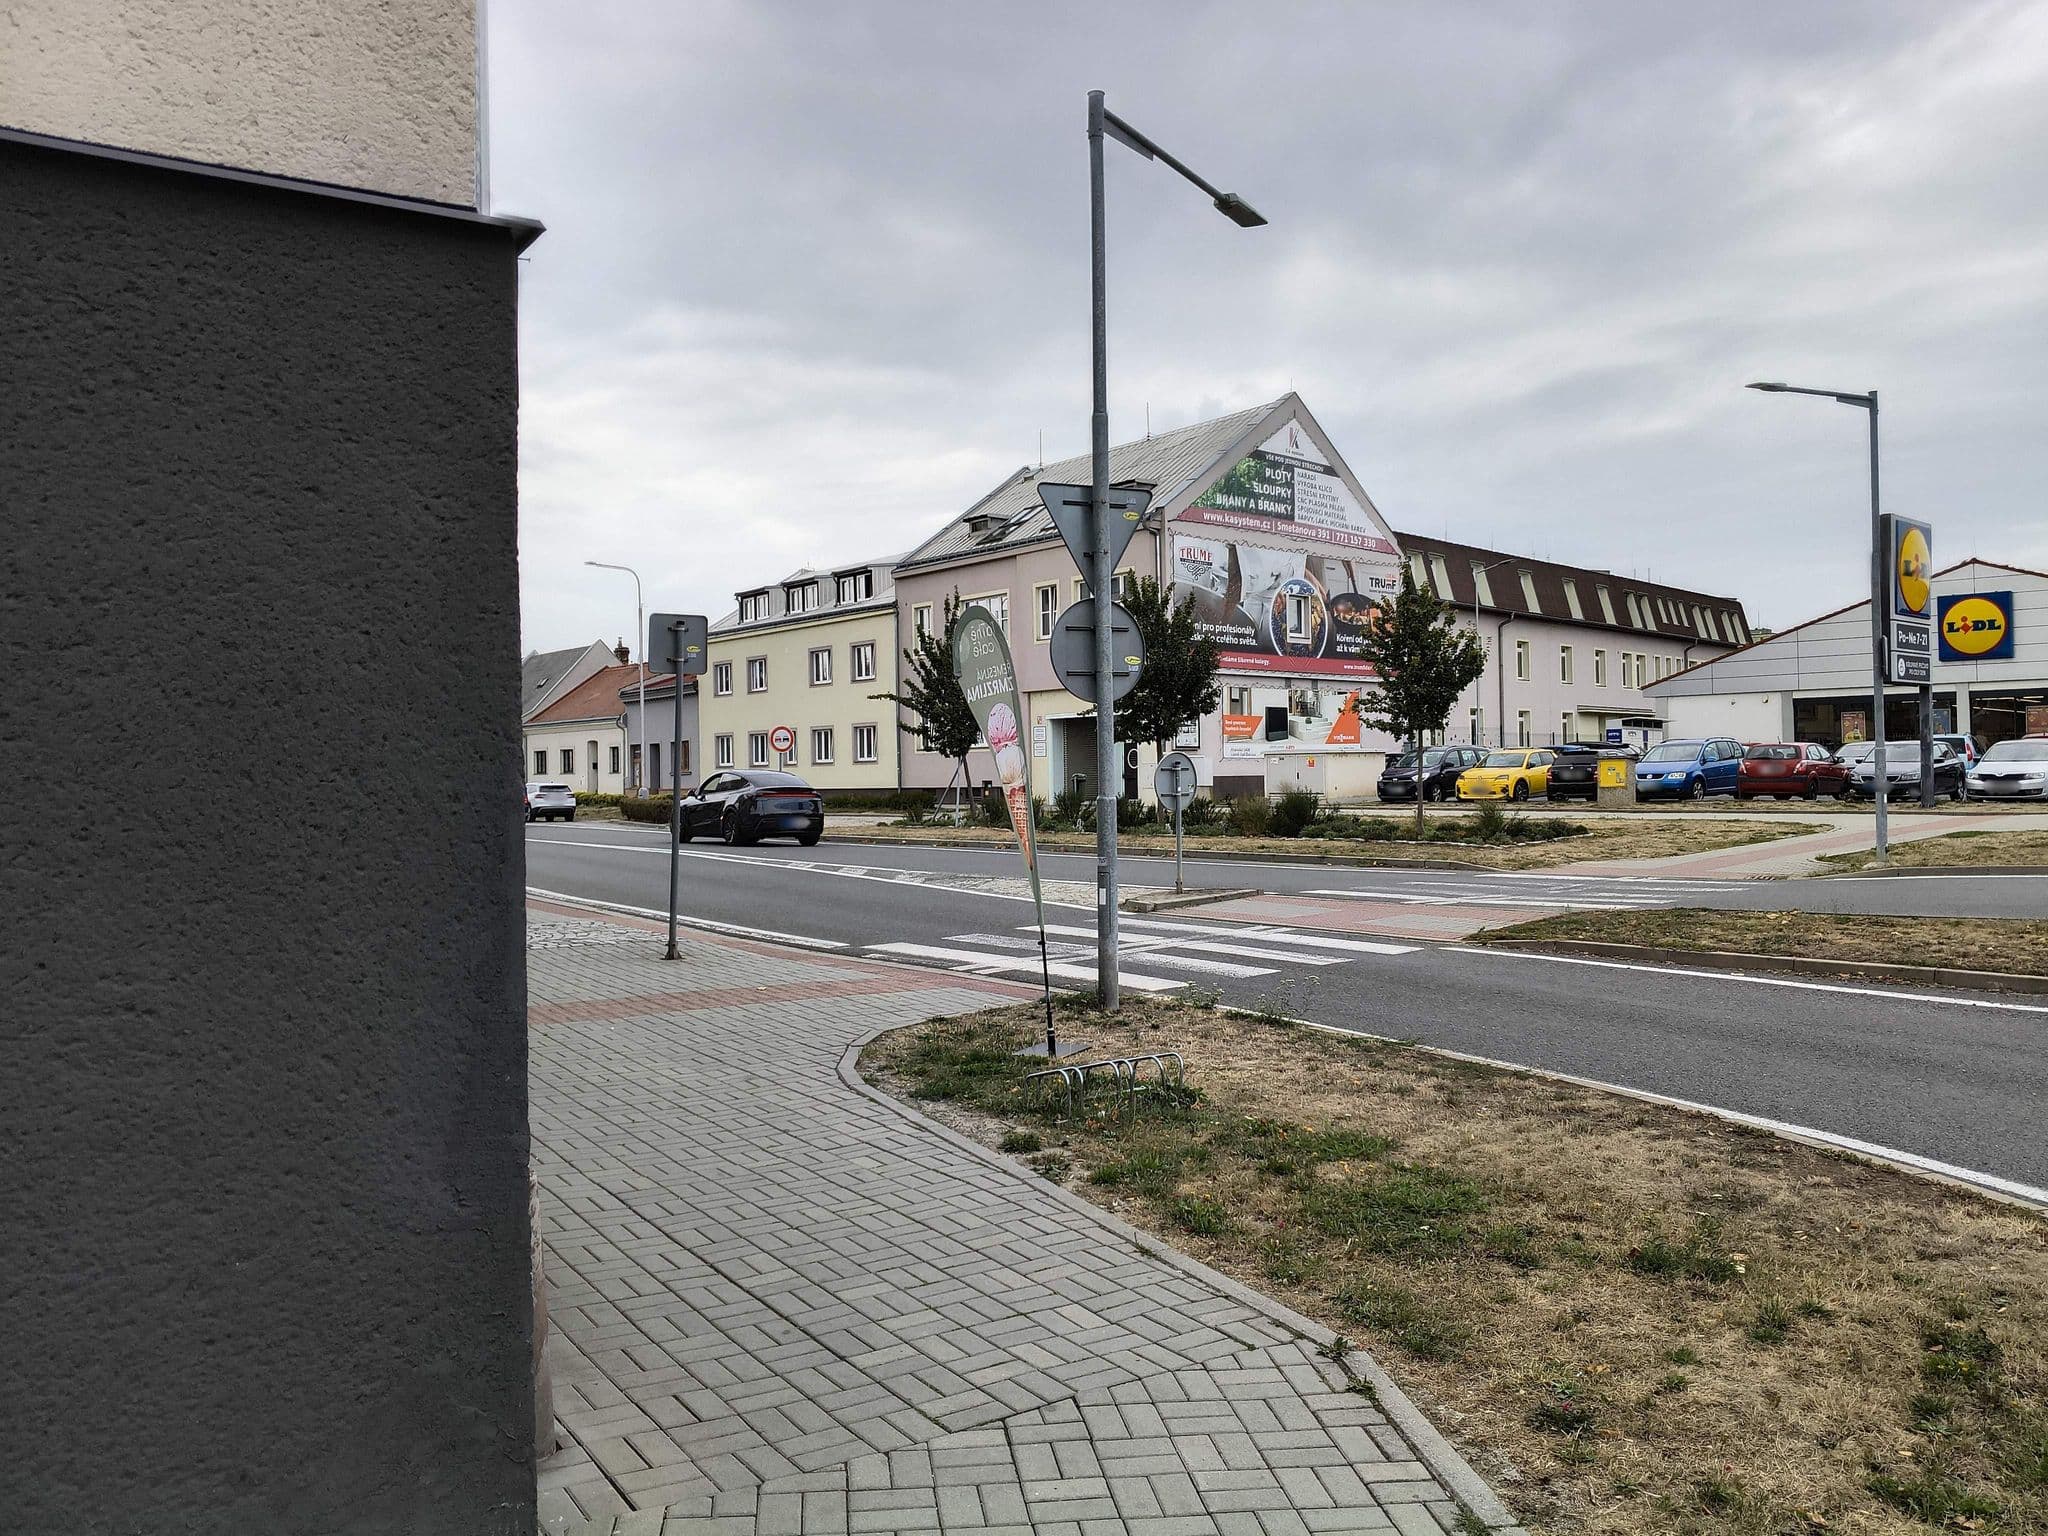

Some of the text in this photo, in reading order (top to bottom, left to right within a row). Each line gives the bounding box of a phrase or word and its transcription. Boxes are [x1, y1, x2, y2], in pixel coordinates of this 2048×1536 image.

[1216, 493, 1292, 515] BRÁNY A BRANKY
[1203, 511, 1376, 548] www.kasystem.cz Smetanova 391 771 157 330
[1202, 622, 1215, 632] pro
